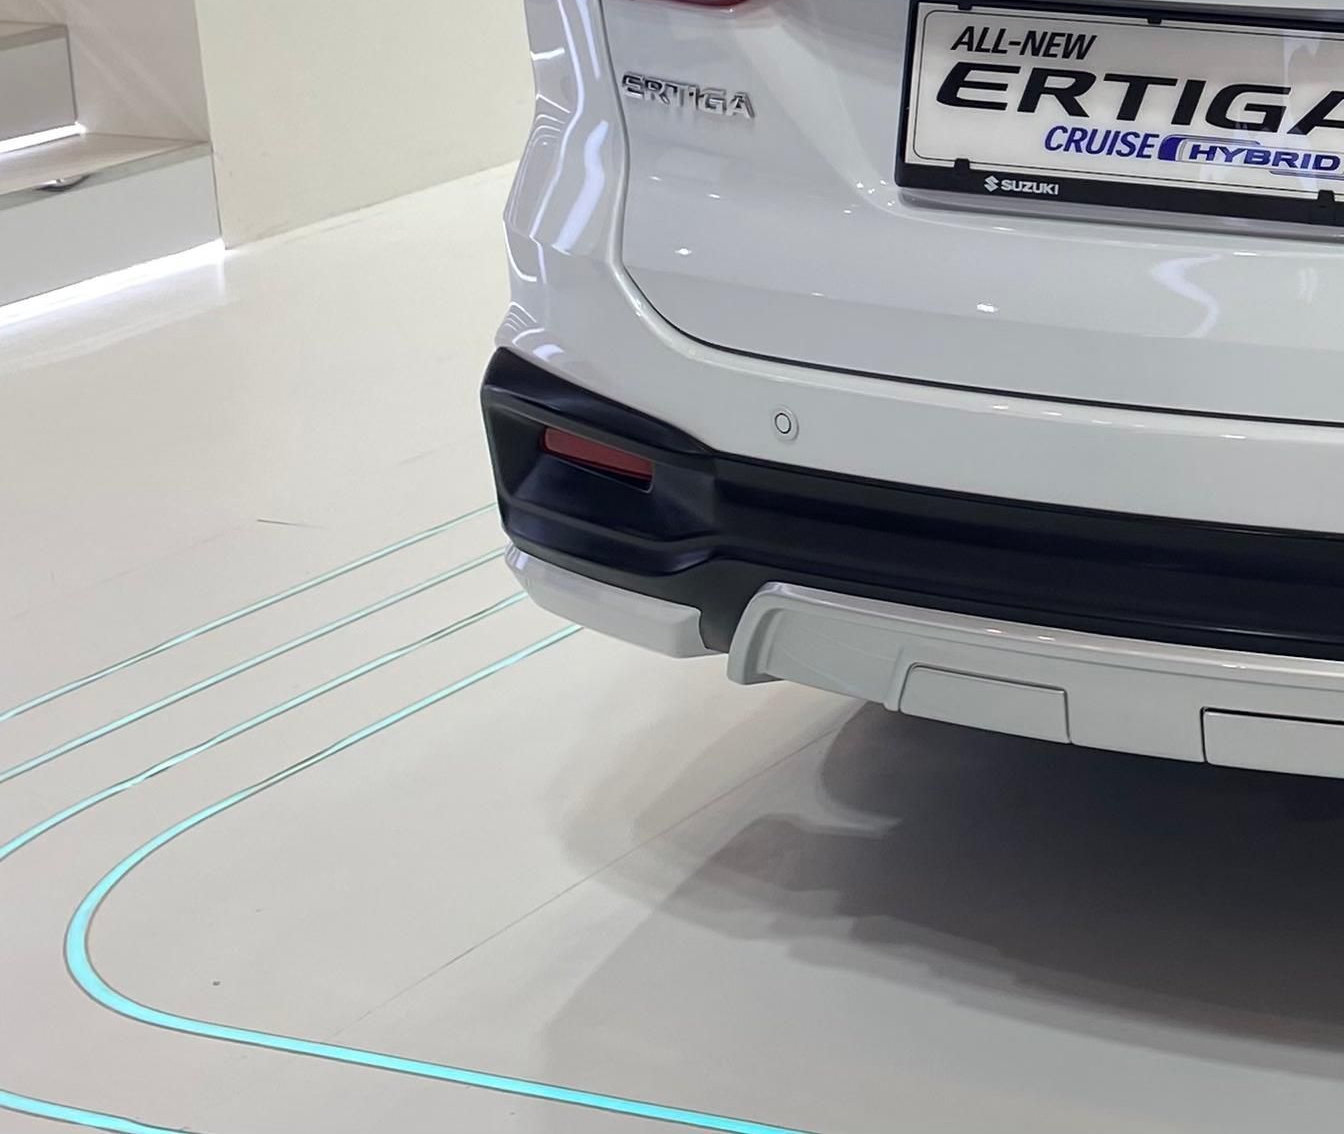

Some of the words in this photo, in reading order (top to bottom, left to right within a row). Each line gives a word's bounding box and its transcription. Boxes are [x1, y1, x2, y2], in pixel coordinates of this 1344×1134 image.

[951, 25, 1097, 61] ALL-NEW
[622, 71, 756, 119] ERTIGA
[1044, 124, 1160, 159] CRUISE
[1188, 143, 1341, 172] HYBRID
[1000, 177, 1060, 196] SUZUKI
